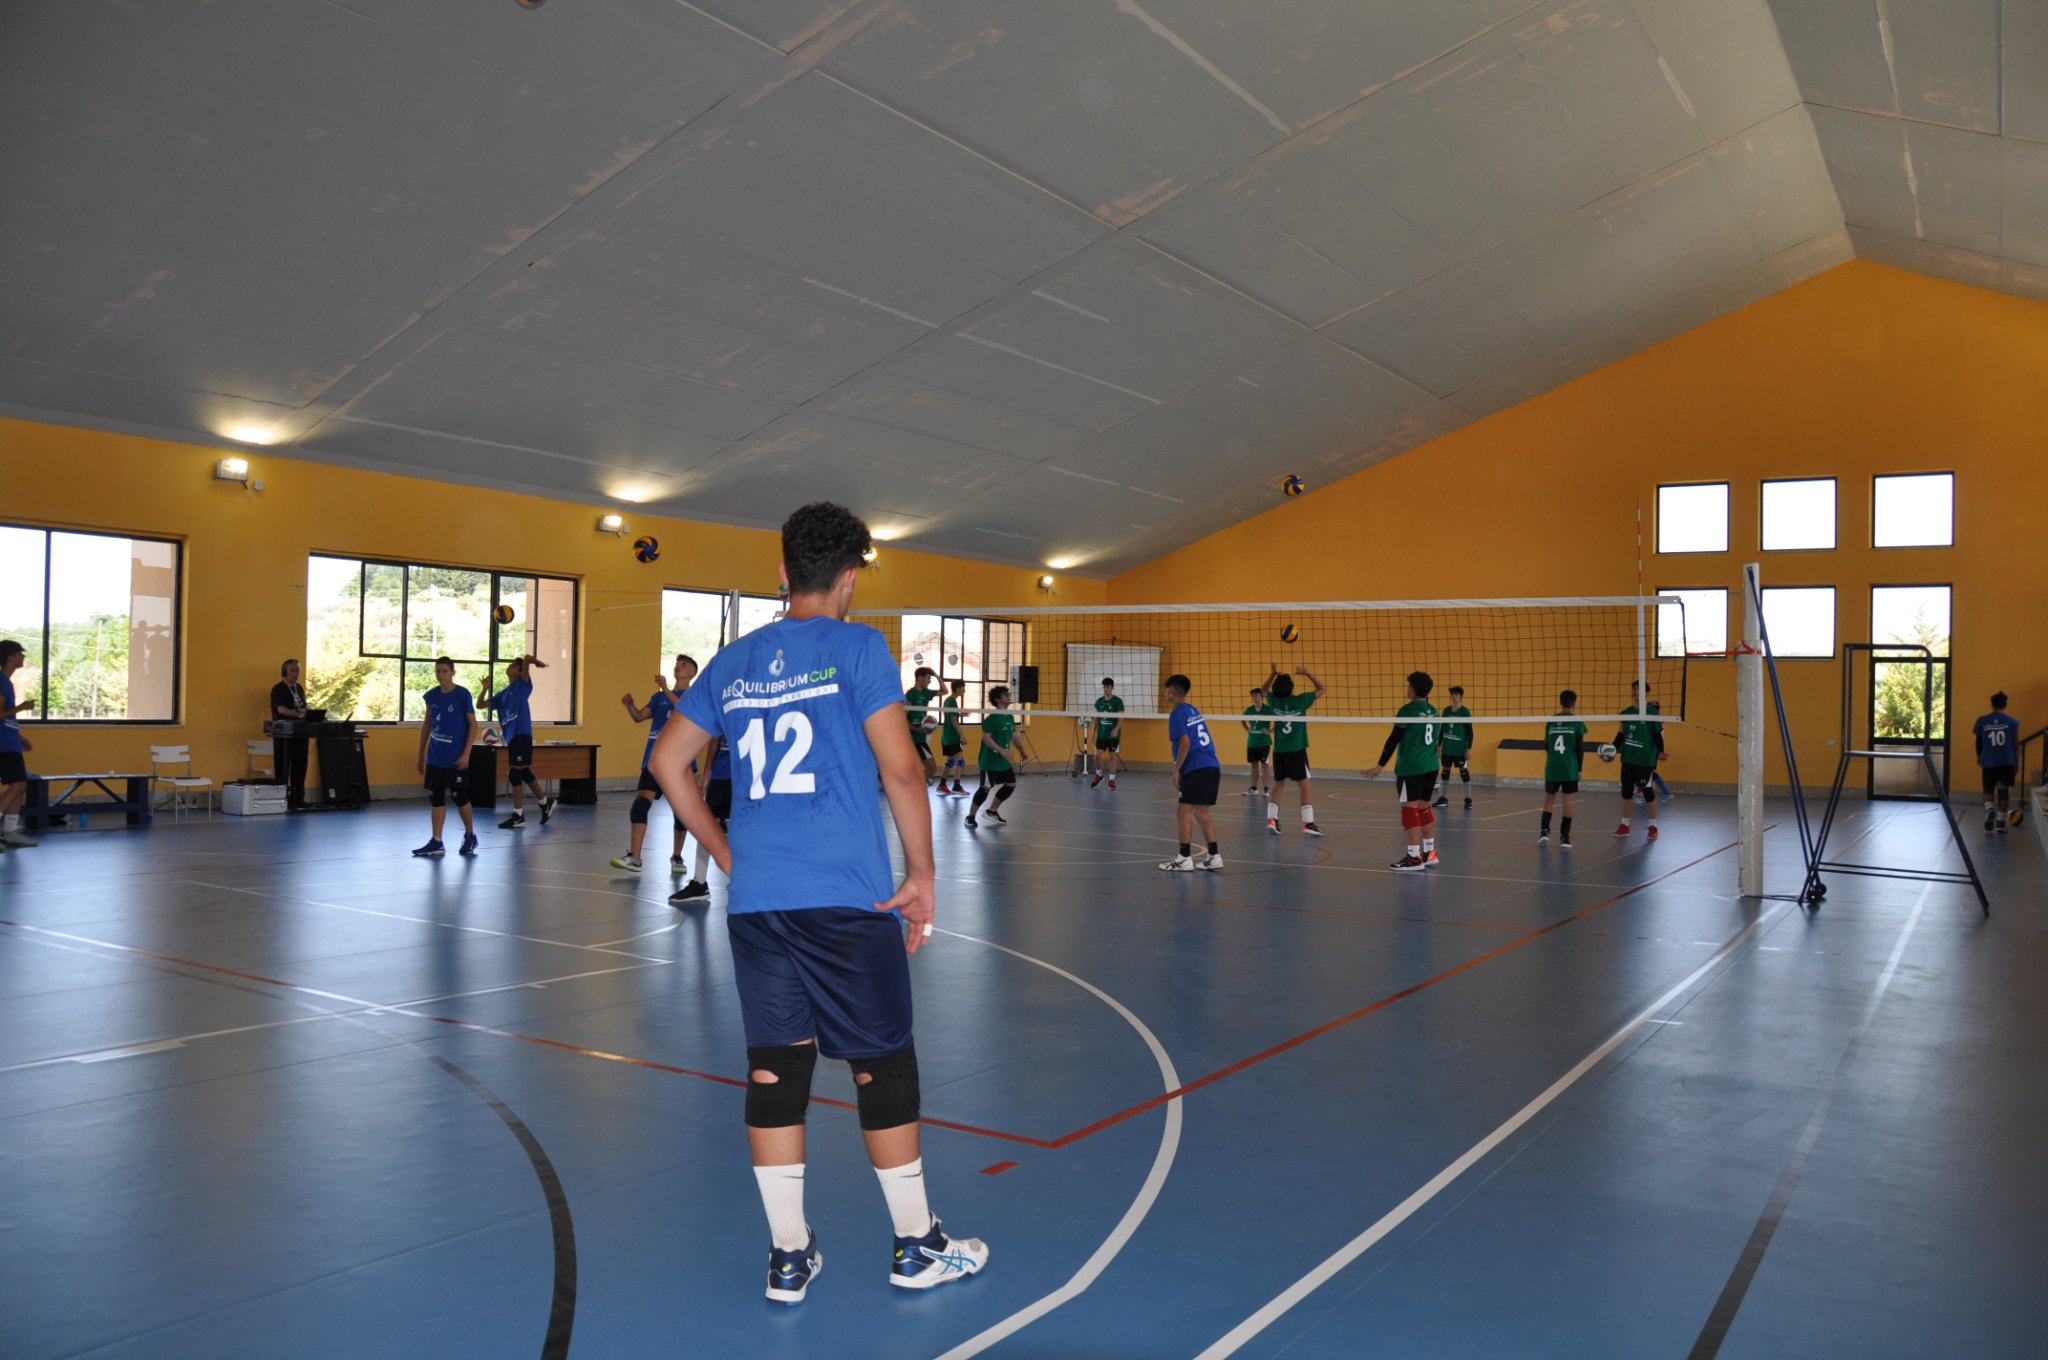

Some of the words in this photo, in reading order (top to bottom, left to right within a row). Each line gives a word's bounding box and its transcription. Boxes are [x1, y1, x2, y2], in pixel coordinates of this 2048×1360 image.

[1197, 724, 1210, 747] 5
[1425, 723, 1434, 746] 8
[1553, 735, 1566, 754] 4
[1987, 730, 2006, 747] 10
[737, 711, 816, 800] 12
